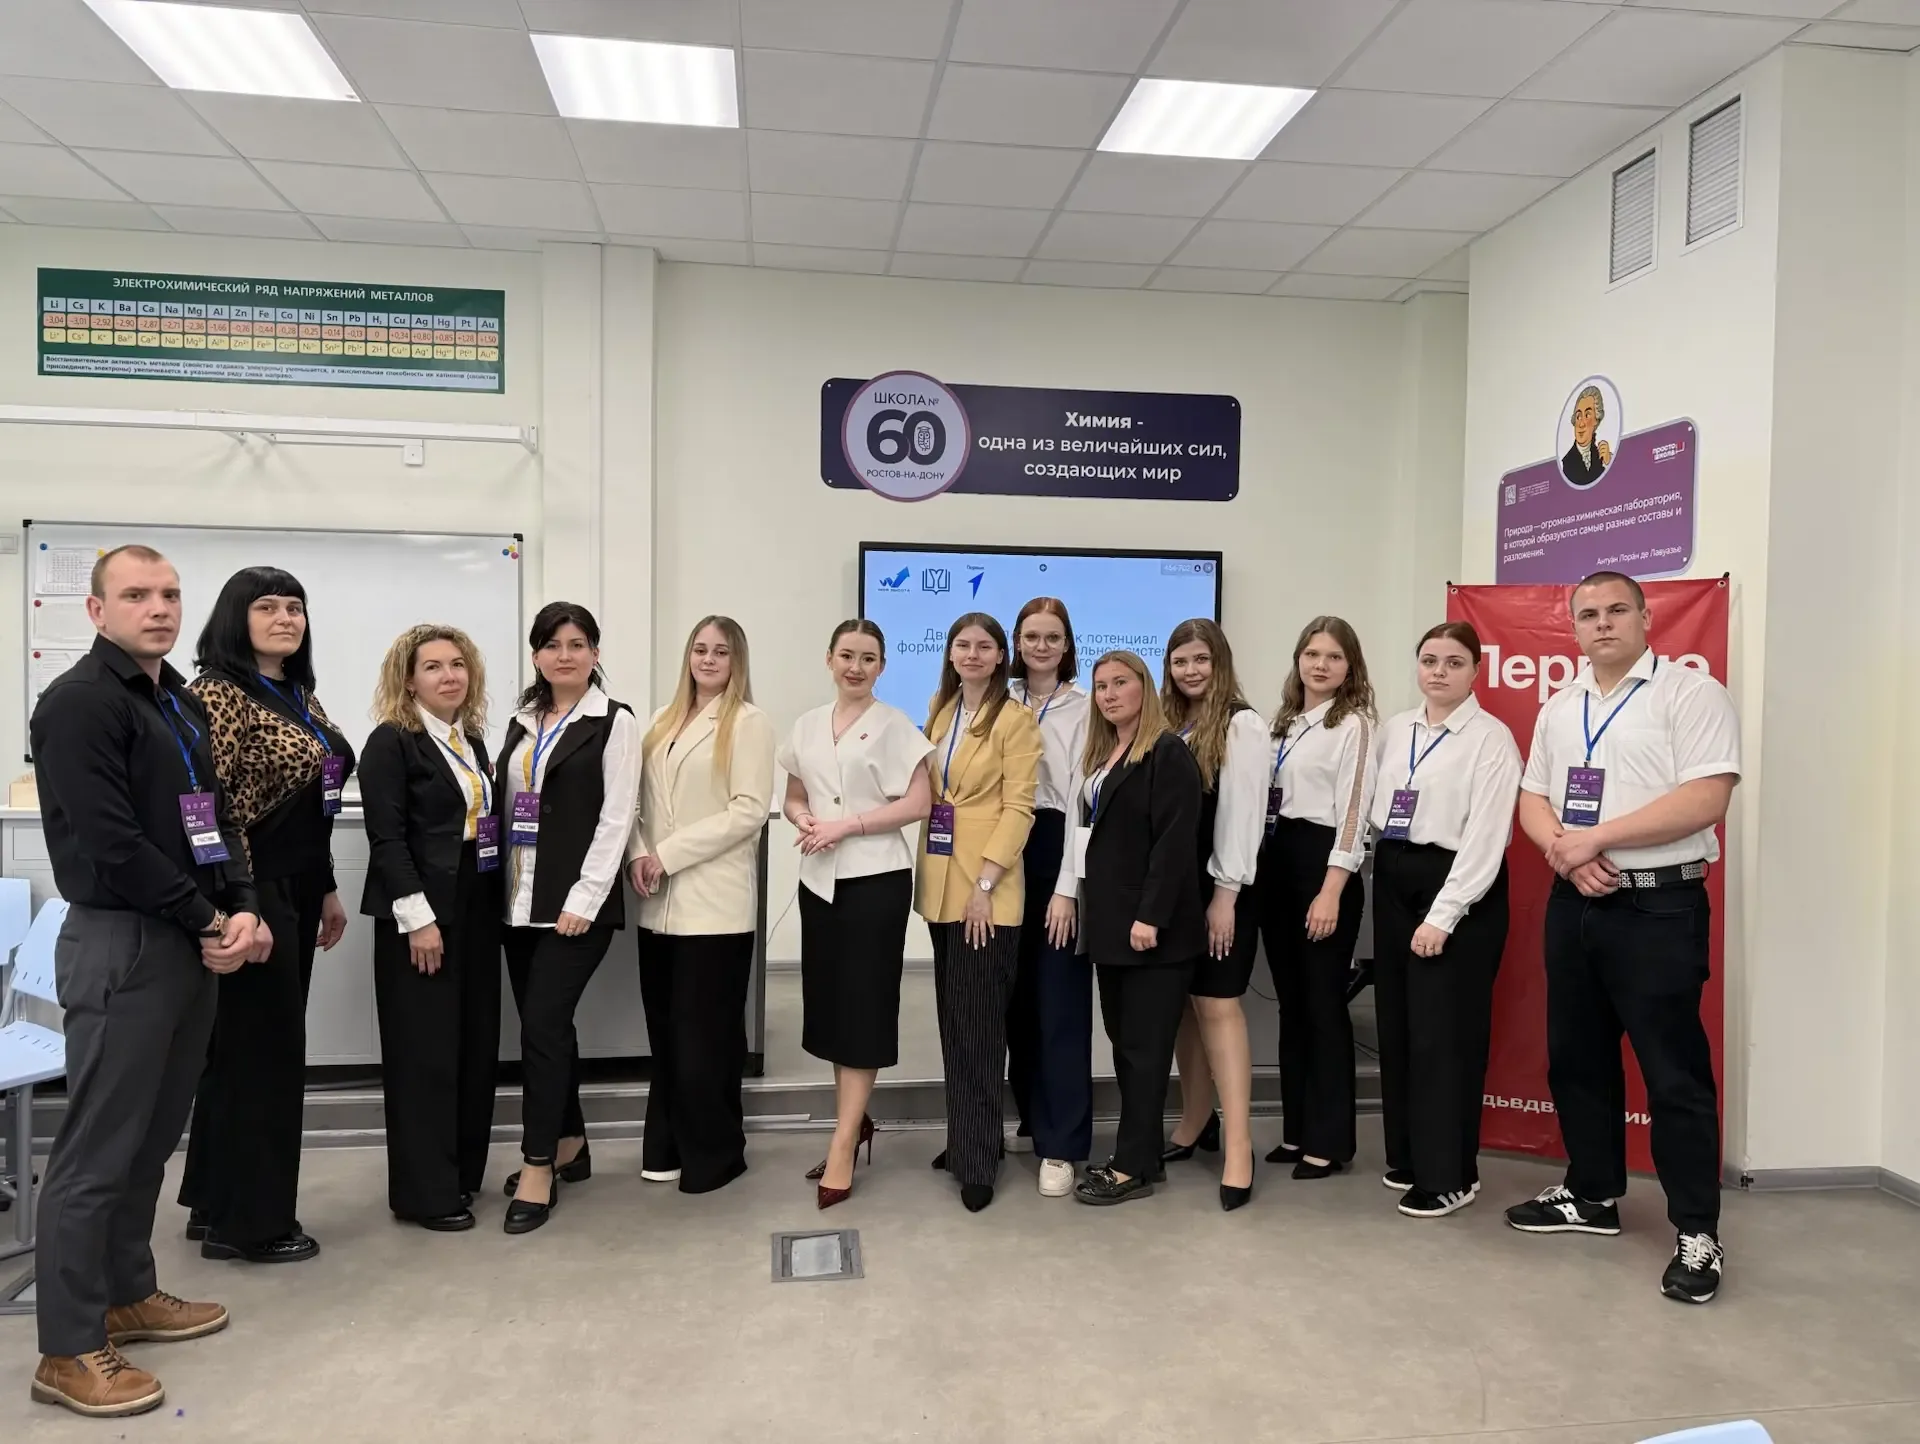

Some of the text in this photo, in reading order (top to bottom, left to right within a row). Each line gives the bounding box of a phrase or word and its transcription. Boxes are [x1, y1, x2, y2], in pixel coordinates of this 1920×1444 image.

[113, 277, 433, 302] ЭЛЕКТРОХИМИЧЕСКИЙ РЯД НАПРЯЖЕНИЙ МЕТАЛЛОВ
[51, 300, 58, 308] Li
[73, 301, 83, 309] Cs
[99, 302, 105, 310] K
[166, 306, 178, 314] Na
[188, 307, 202, 316] Mg
[235, 309, 247, 317] Zn
[260, 310, 269, 318] Fe
[281, 311, 292, 319] Co
[305, 312, 314, 320] Ni
[415, 318, 428, 327] Ag
[438, 318, 450, 328] Hg
[482, 320, 494, 328] Au
[874, 392, 940, 406] ШКОЛА №
[1065, 411, 1132, 429] Химия
[866, 409, 947, 466] 60
[978, 436, 1228, 460] одна из величайших сил,
[866, 469, 945, 480] РОСТОВ-НА-ДОНУ
[1024, 463, 1182, 483] создающих мир
[1504, 524, 1534, 538] Природа
[1540, 515, 1576, 530] огромная
[1576, 505, 1622, 522] химическая
[1623, 492, 1682, 512] лаборатория,
[1509, 534, 1536, 548] которой
[1537, 528, 1578, 544] образуются
[1579, 522, 1604, 535] самые
[1606, 516, 1636, 532] разные
[1638, 508, 1673, 523] составы
[1676, 507, 1682, 515] и
[1504, 548, 1545, 564] разложения.
[1640, 551, 1649, 559] де
[1087, 634, 1158, 646] потенциал
